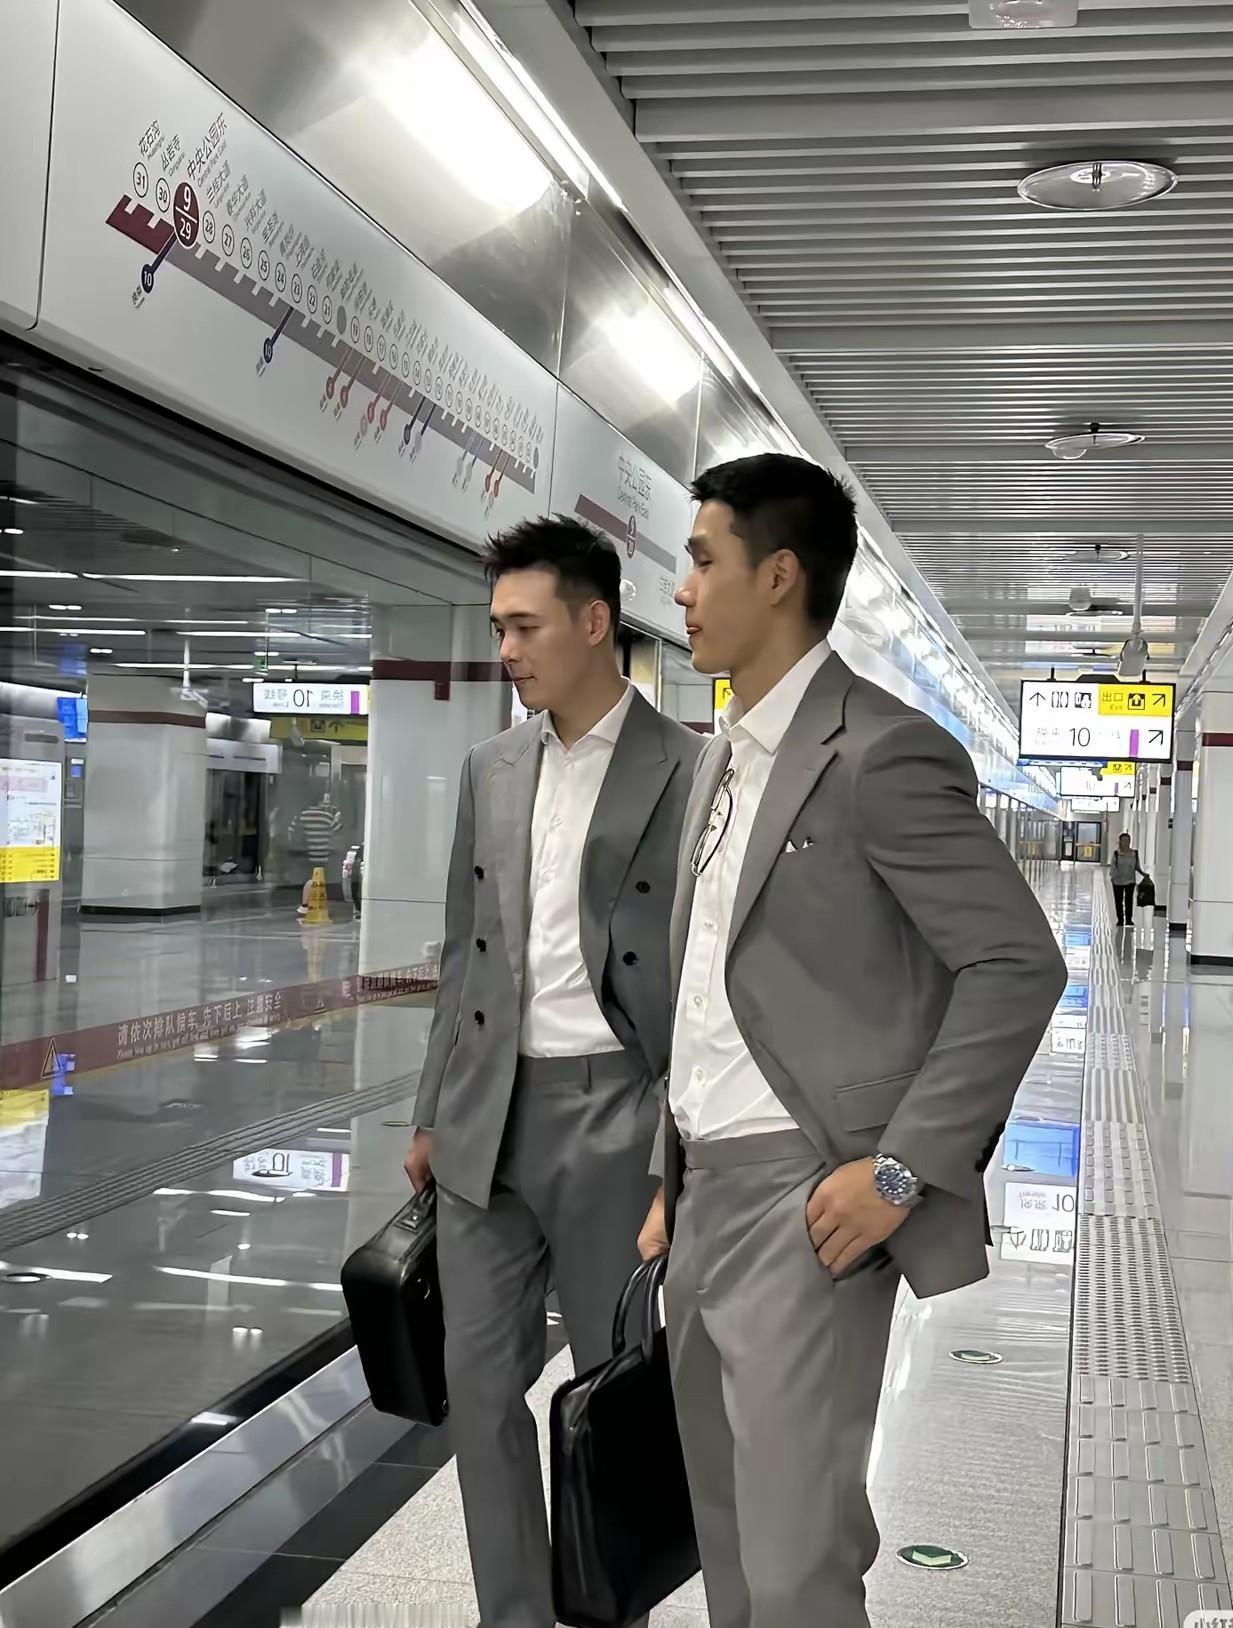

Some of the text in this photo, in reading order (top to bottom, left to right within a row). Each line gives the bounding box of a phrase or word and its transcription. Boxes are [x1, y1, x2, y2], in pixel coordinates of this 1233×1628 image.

[187, 112, 227, 180] 中央公园东
[136, 171, 146, 189] 31
[158, 187, 168, 203] 30
[183, 185, 191, 211] 9
[179, 217, 192, 240] 29
[144, 270, 152, 287] 10
[1102, 692, 1123, 702] 出口
[1069, 727, 1091, 747] 10
